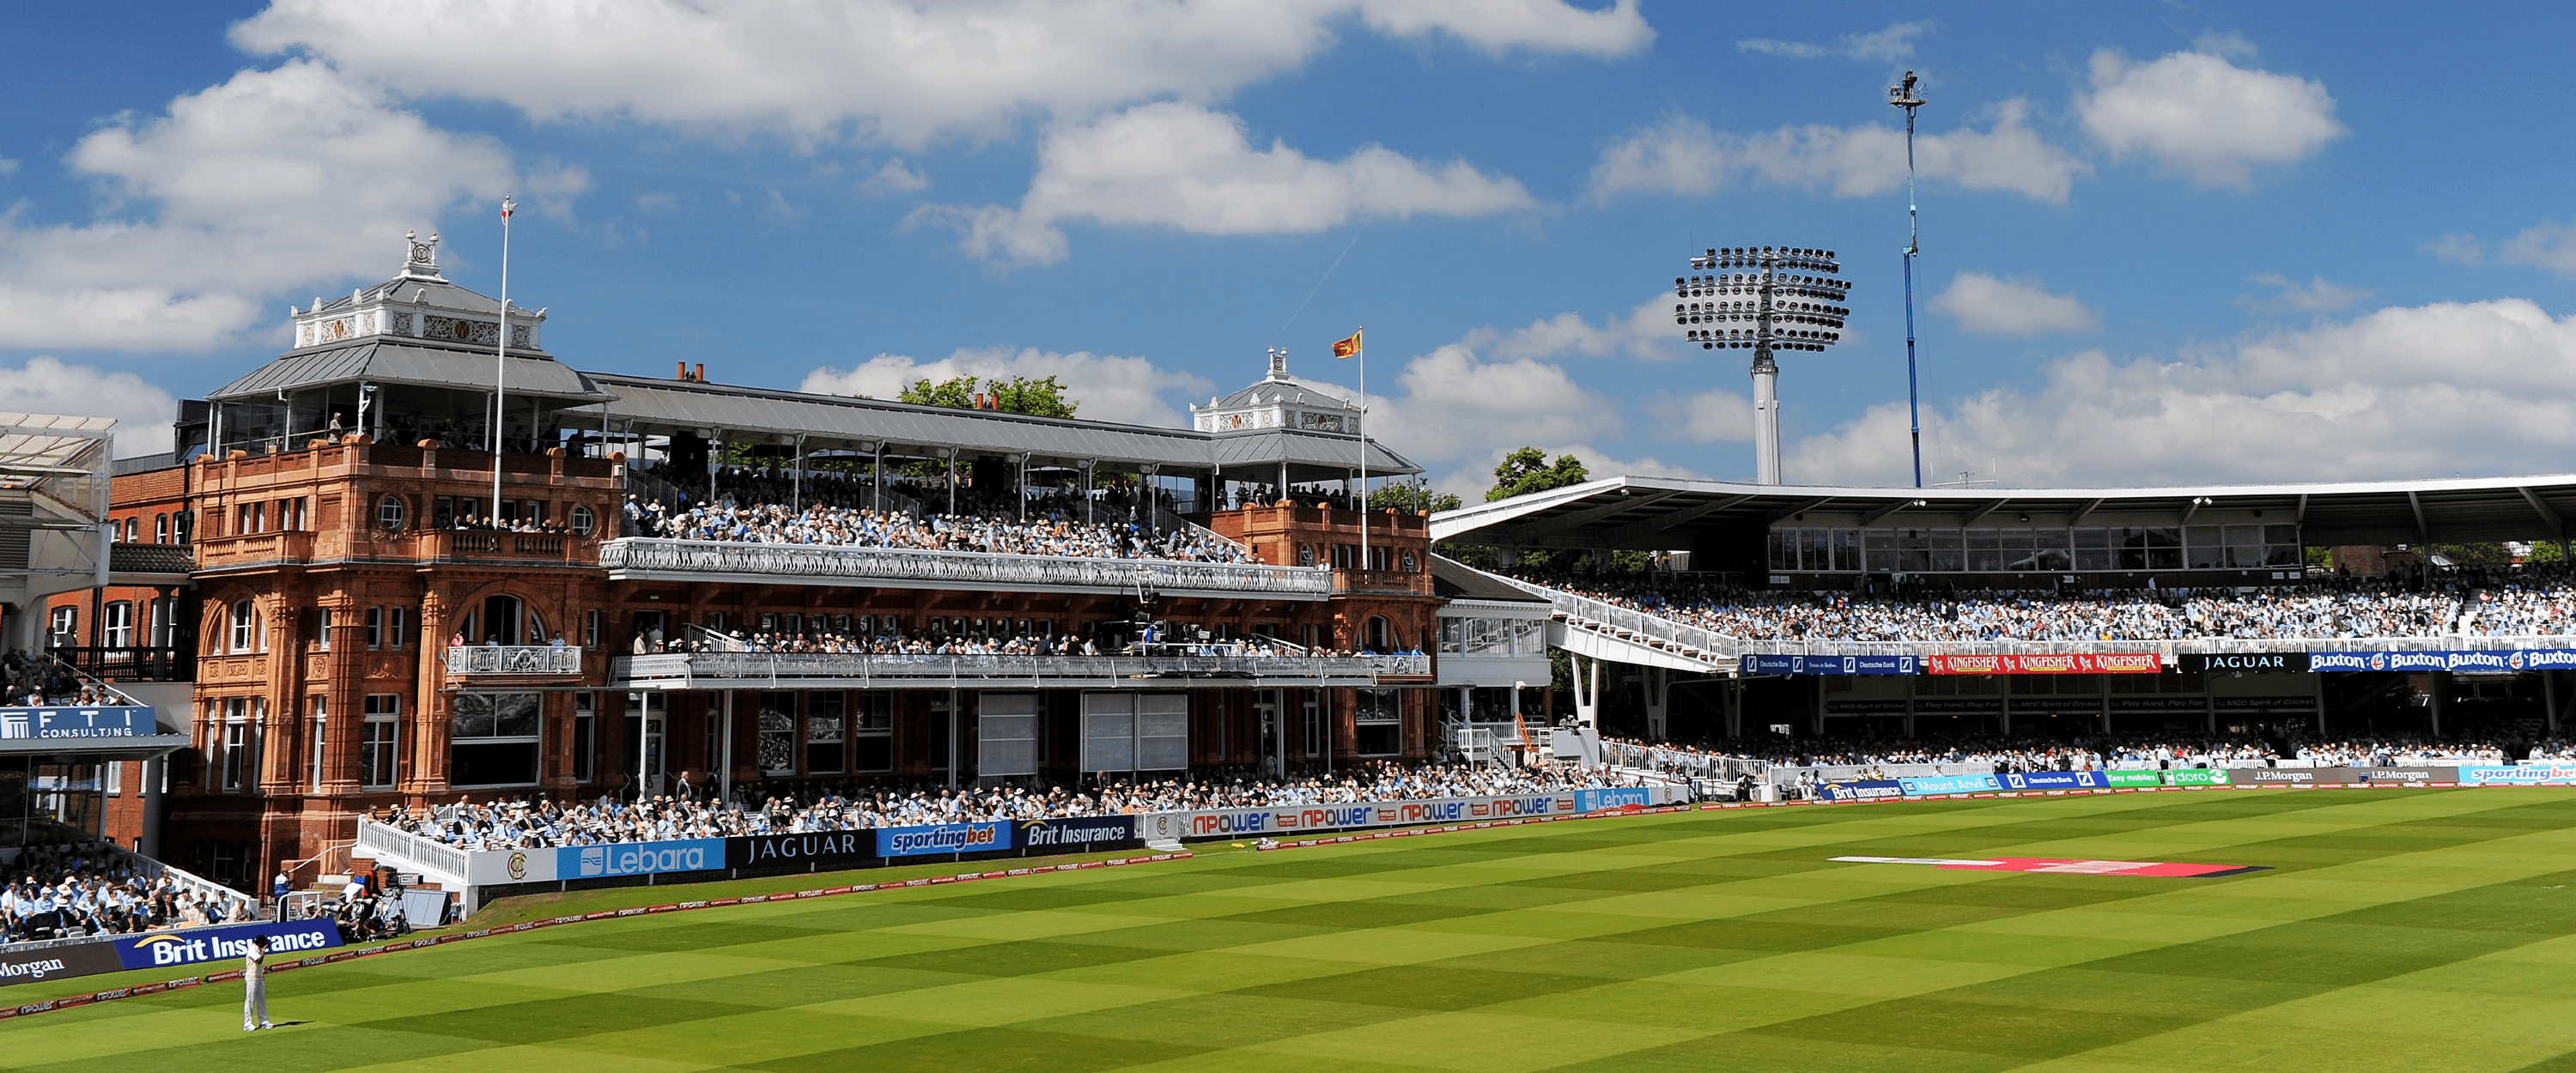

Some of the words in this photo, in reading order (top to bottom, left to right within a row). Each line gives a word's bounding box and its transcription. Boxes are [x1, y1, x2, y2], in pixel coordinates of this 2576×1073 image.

[1947, 656, 2001, 670] KINGFISHER
[2020, 656, 2077, 670] KINGFISHER
[2096, 655, 2157, 670] KINGFISHER
[2205, 656, 2284, 670] JAGUAR
[2311, 653, 2366, 670] Buxton
[2391, 652, 2446, 668] Buxton
[2449, 652, 2504, 668] Buxton
[2530, 651, 2576, 667] Buxto
[40, 727, 132, 738] CONSULTING
[2108, 774, 2125, 783] Easy
[2127, 773, 2156, 782] mobiles
[2175, 770, 2208, 782] doro
[2254, 771, 2313, 783] J.P.Morgan
[2472, 767, 2576, 781] sportingbe
[1917, 780, 1957, 791] Mount
[1958, 778, 1985, 790] Anvil
[1832, 786, 1856, 800] Brit
[1856, 786, 1902, 798] Insurance
[891, 824, 996, 852] sportingbet
[1028, 824, 1058, 846] Brit
[1060, 823, 1126, 843] Insurance
[748, 835, 855, 864] JAGUAR
[605, 844, 704, 875] Lebara
[153, 939, 208, 965] Brit
[211, 931, 325, 959] Insance
